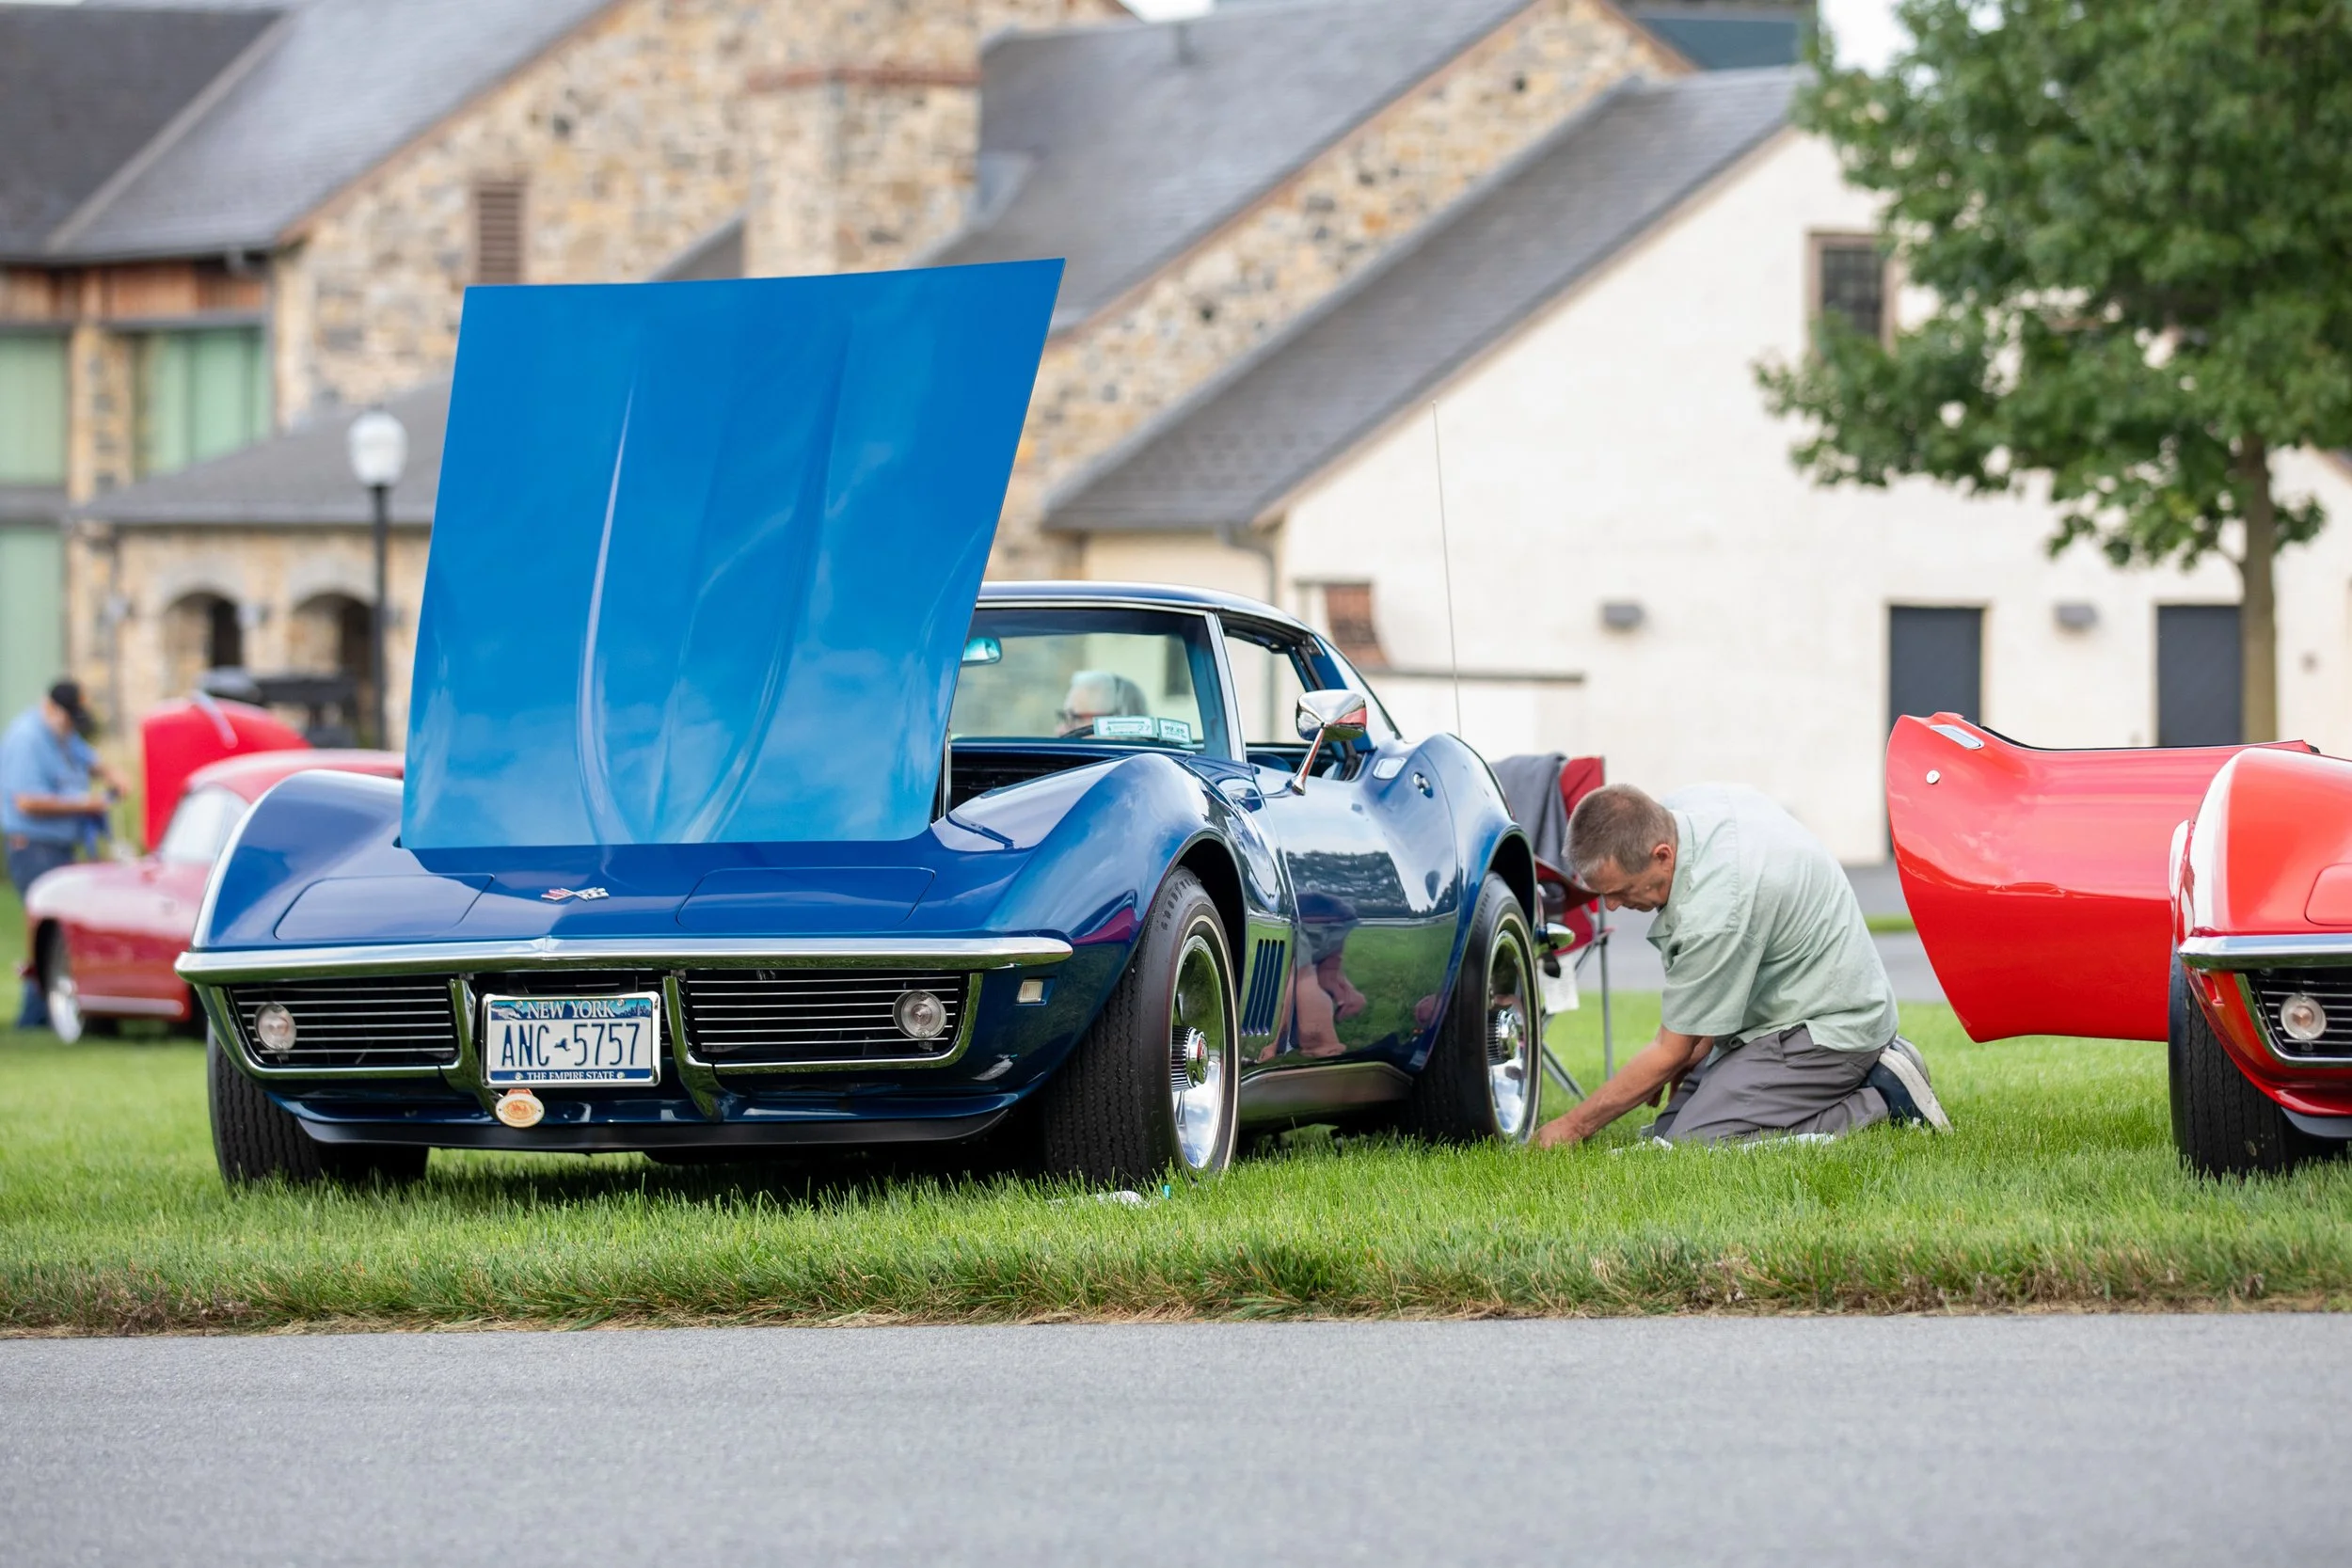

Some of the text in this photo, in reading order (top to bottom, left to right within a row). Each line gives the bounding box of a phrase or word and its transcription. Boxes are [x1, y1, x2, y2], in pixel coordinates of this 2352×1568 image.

[526, 1000, 615, 1019] NEW YORK
[501, 1022, 640, 1067] ANC 5757
[527, 1070, 614, 1081] THE EMPIRE STATE
